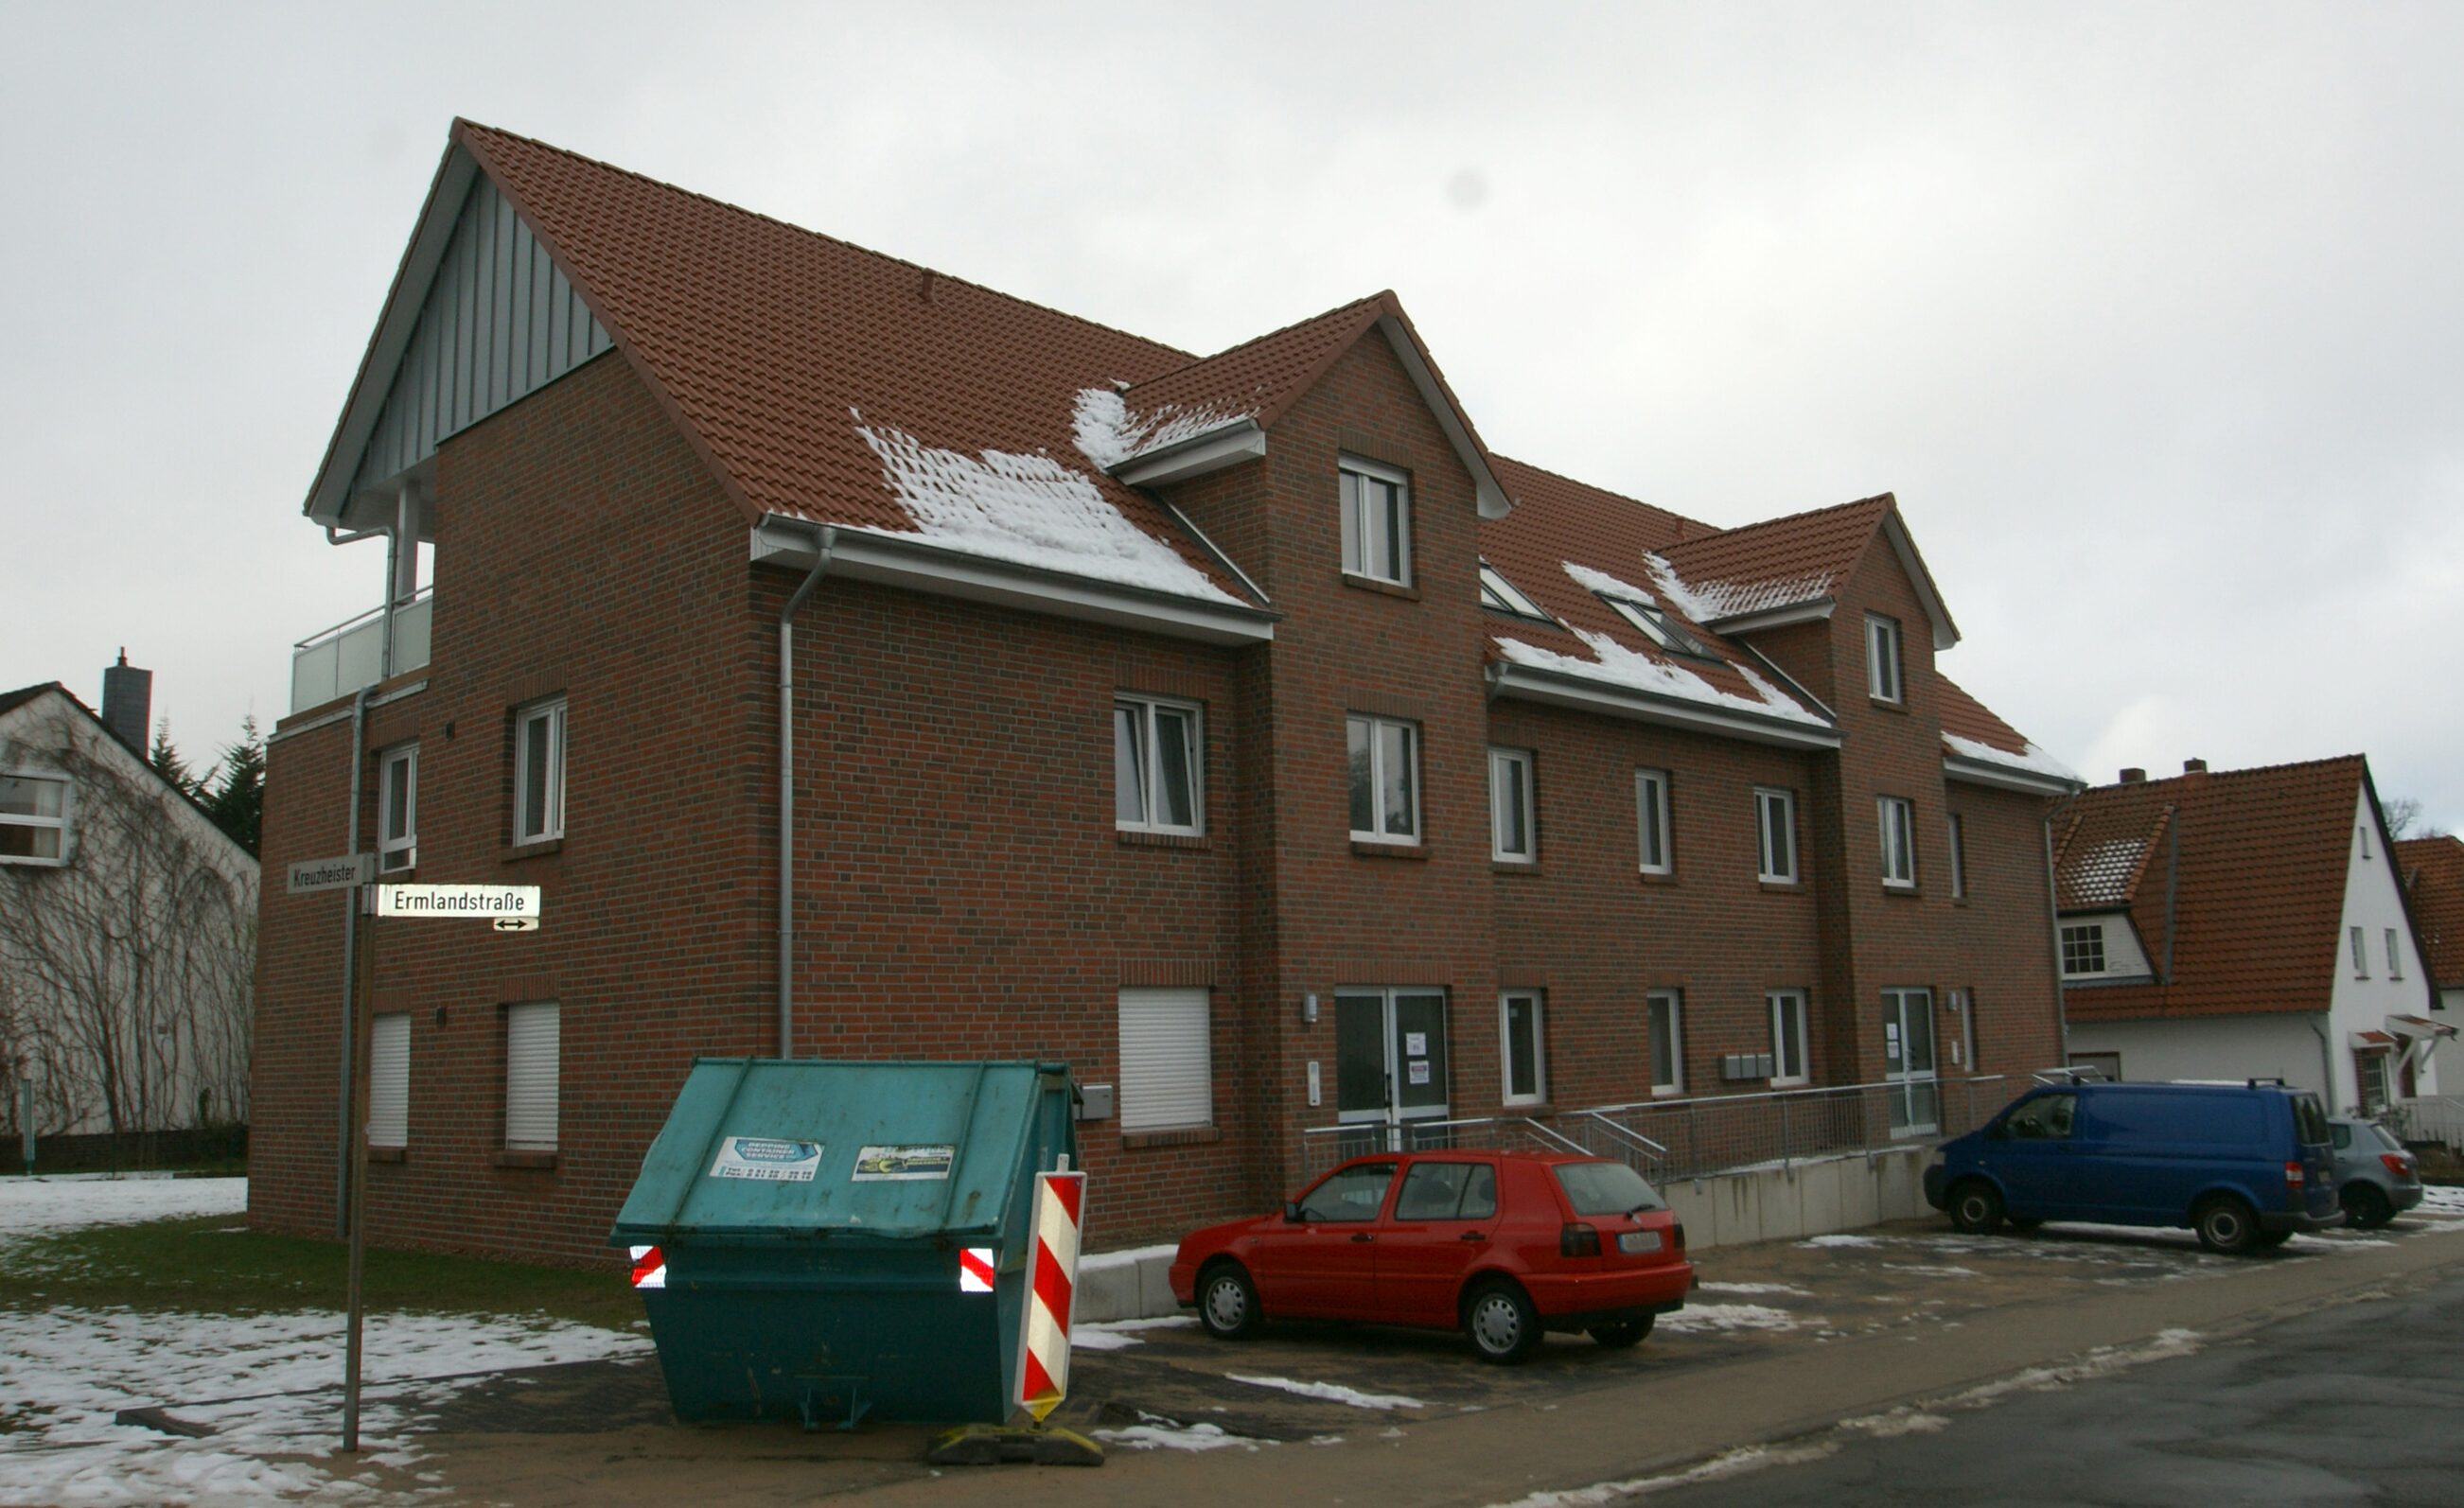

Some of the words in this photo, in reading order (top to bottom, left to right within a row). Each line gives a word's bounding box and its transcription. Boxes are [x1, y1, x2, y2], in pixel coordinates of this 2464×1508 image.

[293, 865, 357, 887] Kreuzheister
[395, 891, 525, 911] Ermlandstraße
[741, 1147, 795, 1155] CONTAINER
